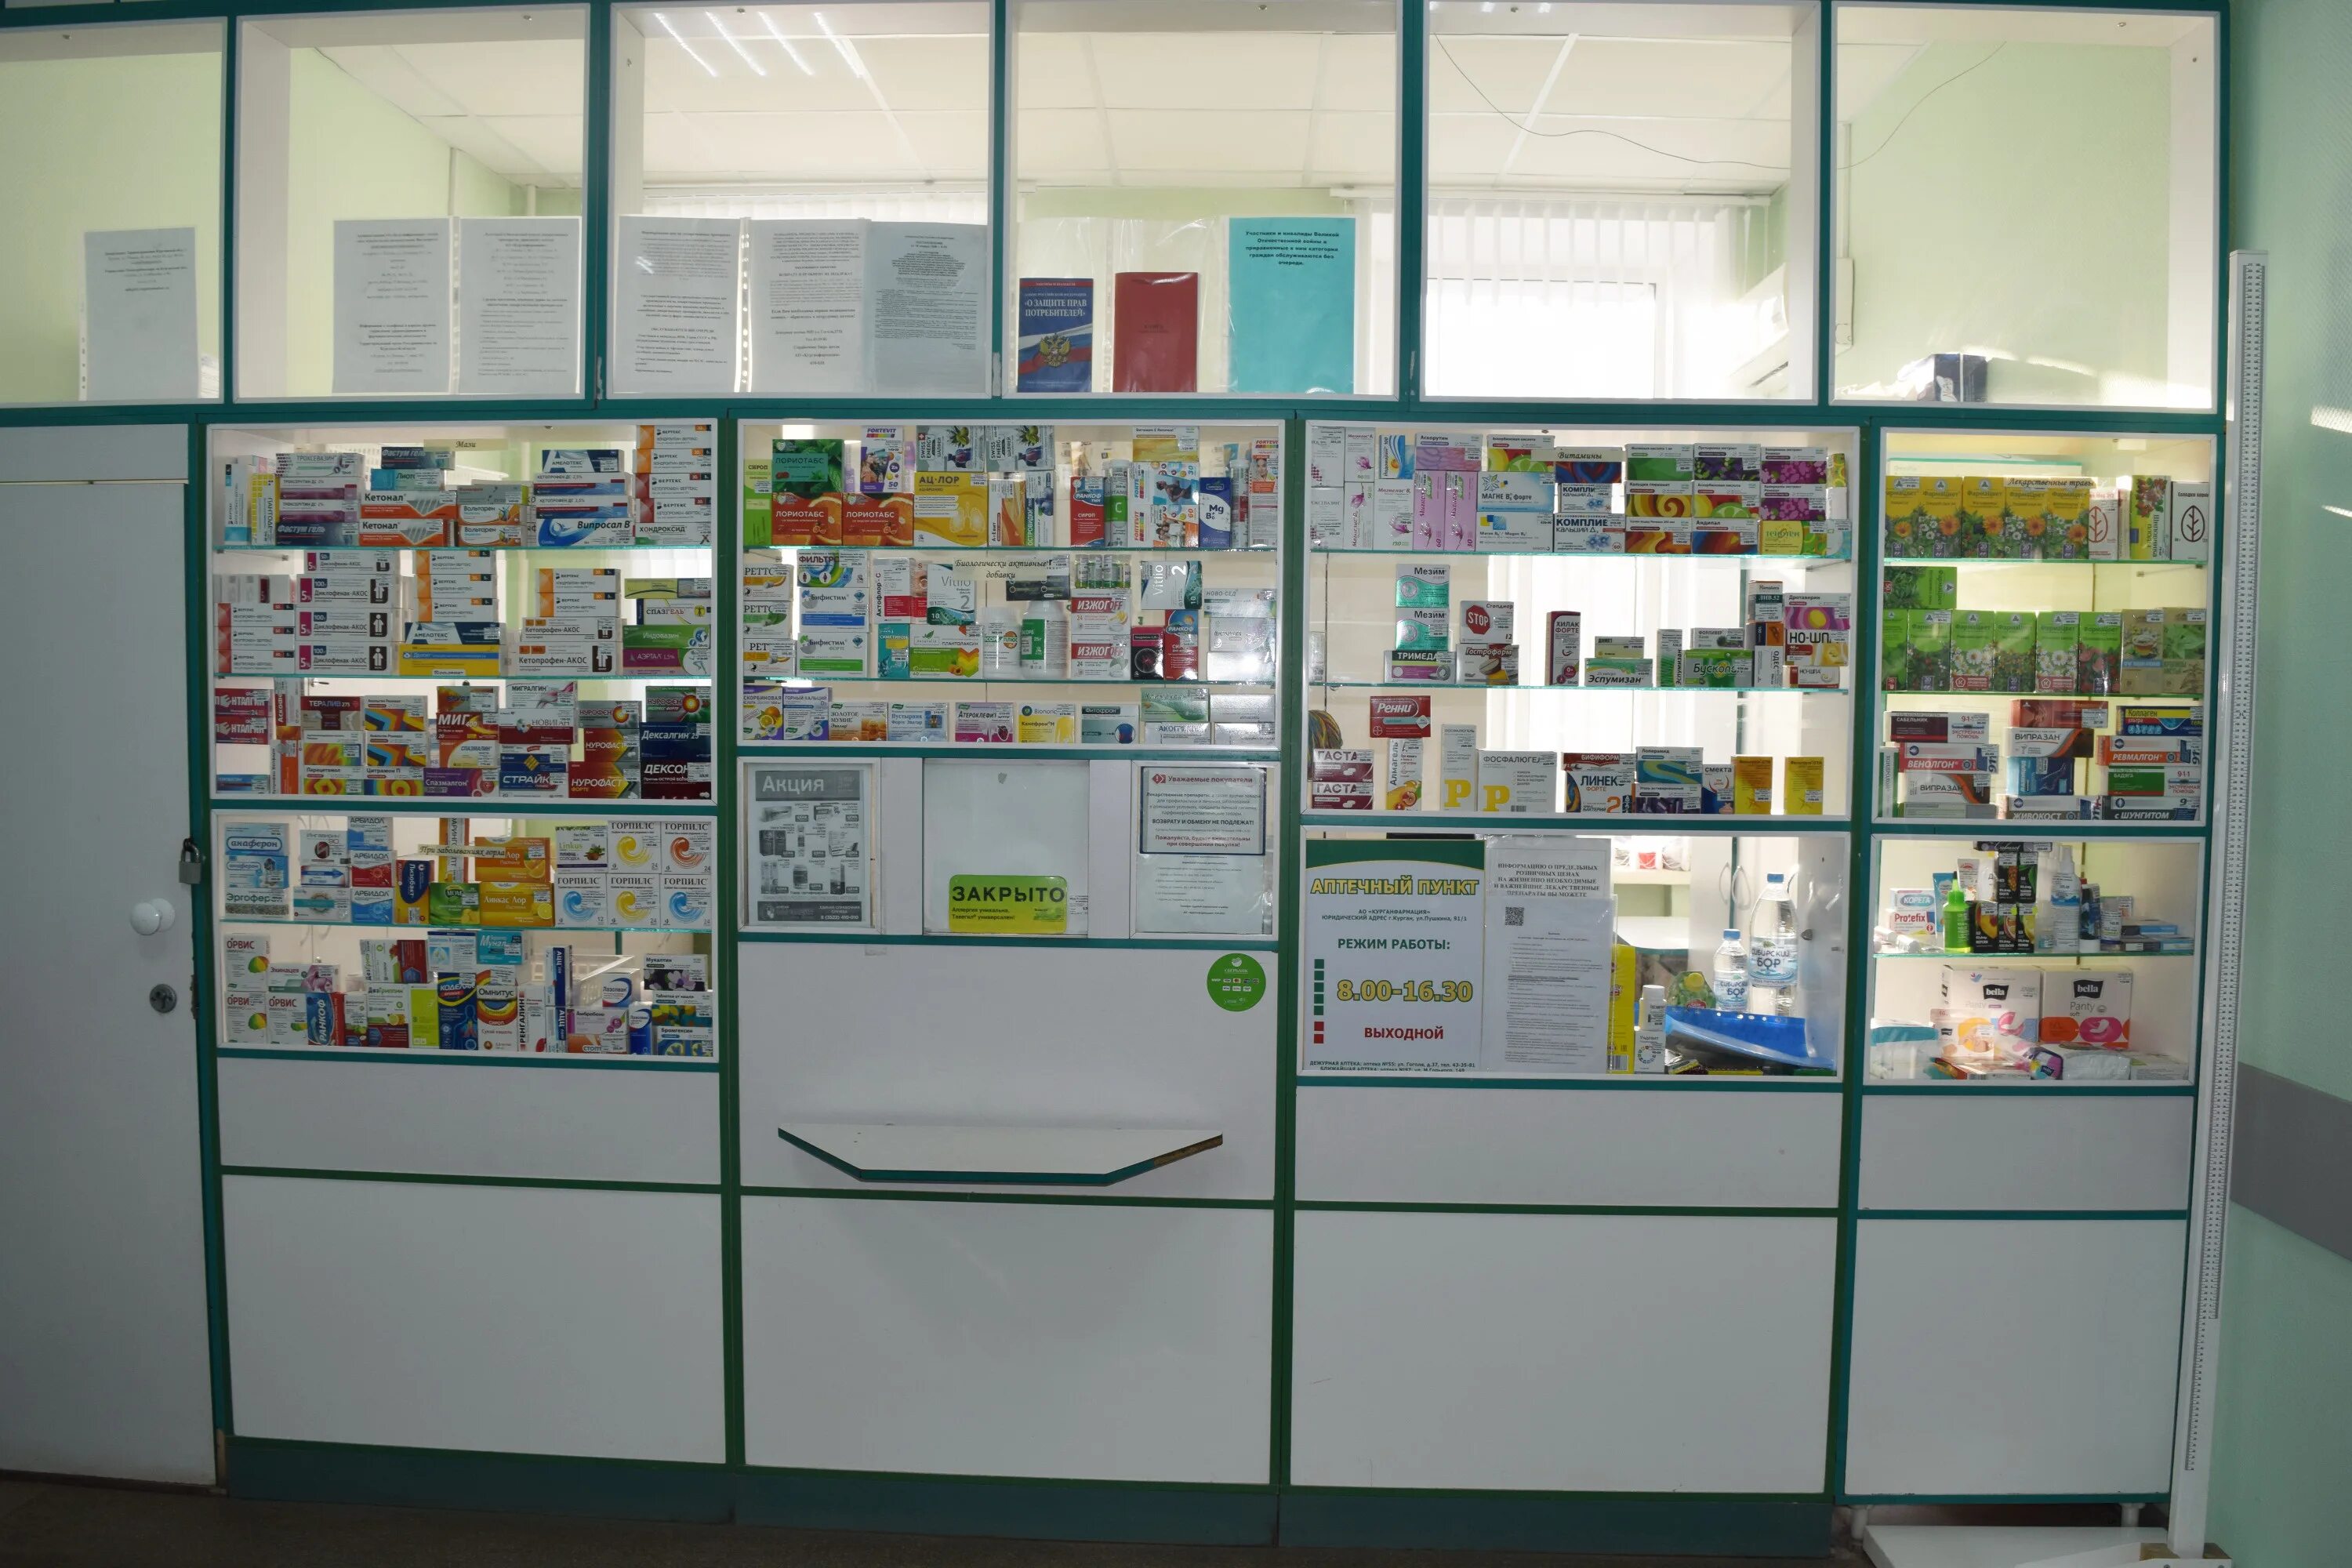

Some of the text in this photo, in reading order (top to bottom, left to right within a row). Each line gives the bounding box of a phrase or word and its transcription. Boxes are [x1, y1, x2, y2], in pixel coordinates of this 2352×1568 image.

[1558, 451, 1602, 459] Витамины
[2008, 478, 2067, 488] Лекарственные
[365, 493, 405, 502] Кетонал
[1210, 504, 1224, 514] Mg
[577, 521, 622, 530] Випросал
[955, 559, 1006, 568] Биологически
[985, 570, 1015, 579] добавки
[1468, 612, 1488, 626] STOP
[519, 656, 586, 666] Кетопрофен-АКОС
[1588, 675, 1642, 684] Эспумизан
[1377, 702, 1411, 713] Ренни
[438, 714, 467, 725] МИГ
[641, 731, 690, 740] Дексалгин
[426, 779, 467, 787] Спазмалгон
[503, 775, 549, 784] СТРАЙК
[572, 778, 621, 787] НУРОФАСТ
[762, 775, 824, 794] Акция
[2121, 811, 2169, 820] ШУНГИТОМ
[231, 839, 278, 849] анаферон
[485, 847, 506, 855] горла
[1310, 875, 1479, 896] АПТЕЧНЫЙ ПУНКТ
[952, 886, 1065, 902] ЗАКРЫТО
[1895, 913, 1926, 923] Protefix
[227, 940, 255, 949] ОРВИС
[1338, 938, 1450, 949] РЕЖИМ РАБОТЫ:
[1757, 957, 1780, 970] БОР
[478, 989, 514, 997] Омнитус
[1336, 980, 1473, 1002] 8.00-16.30
[1727, 988, 1744, 998] БОР
[1986, 988, 2005, 996] bella
[2078, 984, 2099, 993] bella
[2070, 1002, 2096, 1012] Panty
[1365, 1026, 1443, 1040] ВЫХОДНОЙ
